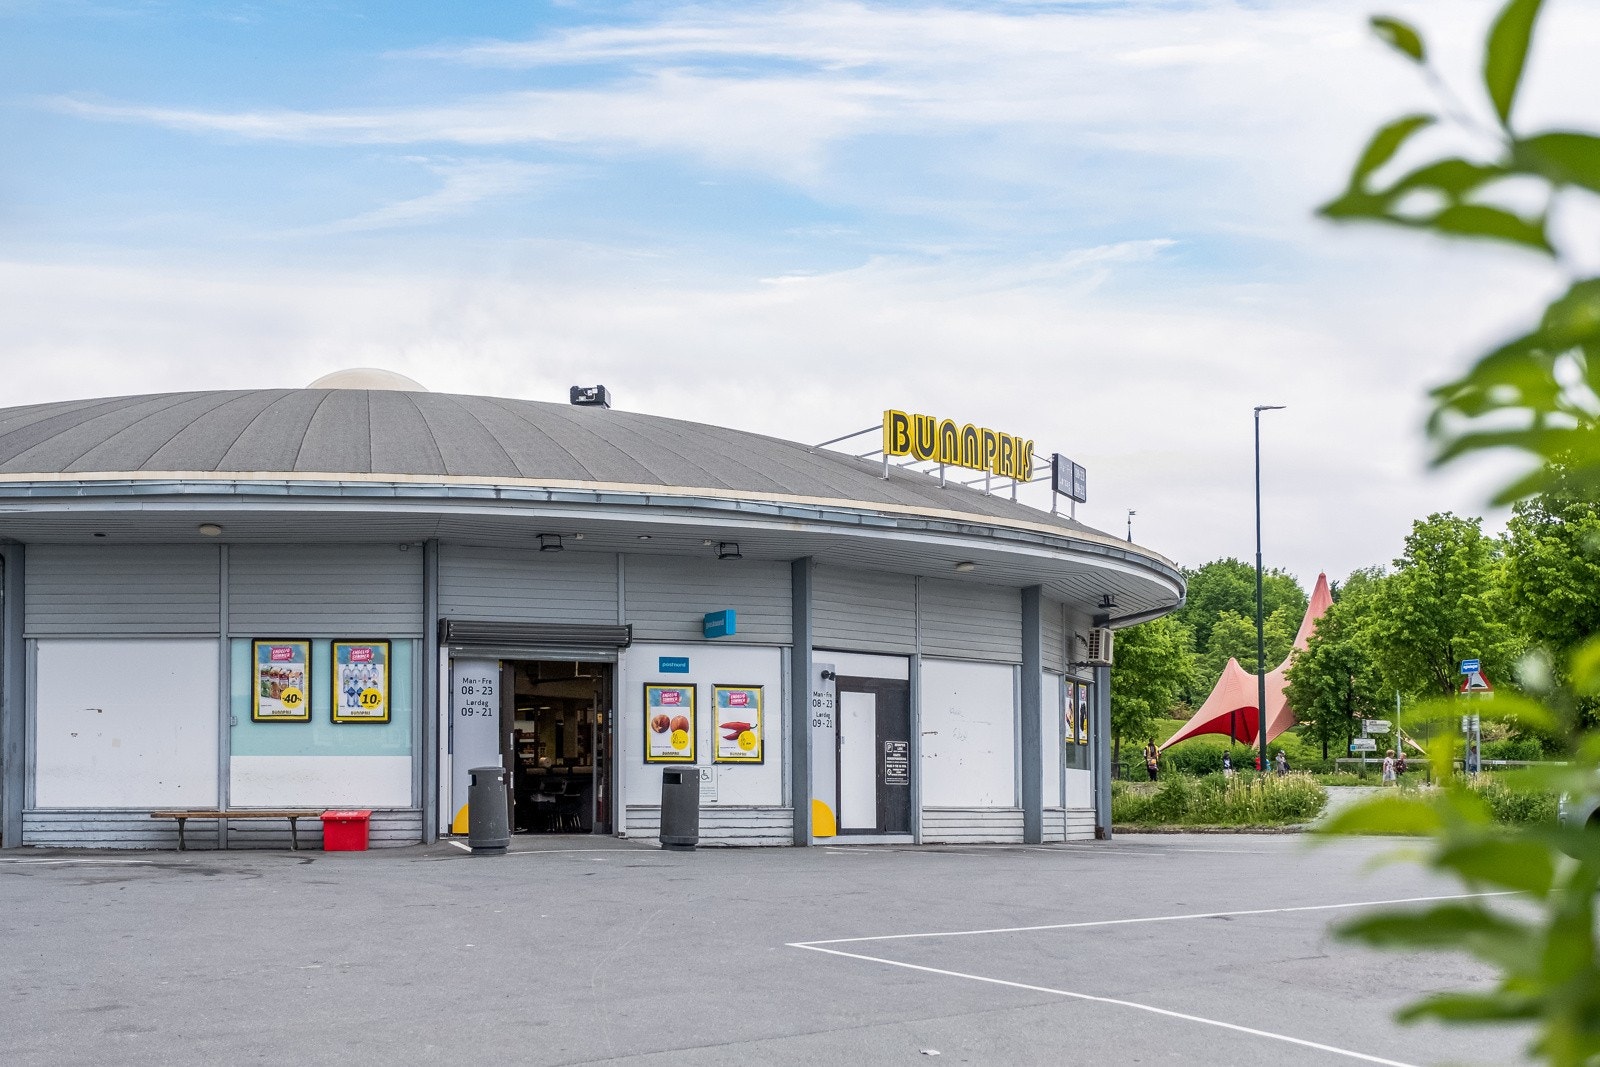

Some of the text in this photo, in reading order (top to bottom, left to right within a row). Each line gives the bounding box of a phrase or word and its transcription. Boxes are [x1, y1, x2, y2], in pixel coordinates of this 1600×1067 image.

[884, 409, 1034, 482] BUNNPRIS
[461, 686, 474, 695] 08
[482, 686, 493, 695] 23
[466, 699, 489, 707] Lørdag
[813, 699, 821, 707] 08
[826, 700, 832, 708] 23
[461, 707, 473, 716] 09
[482, 708, 492, 716] 21
[813, 719, 821, 728] 09
